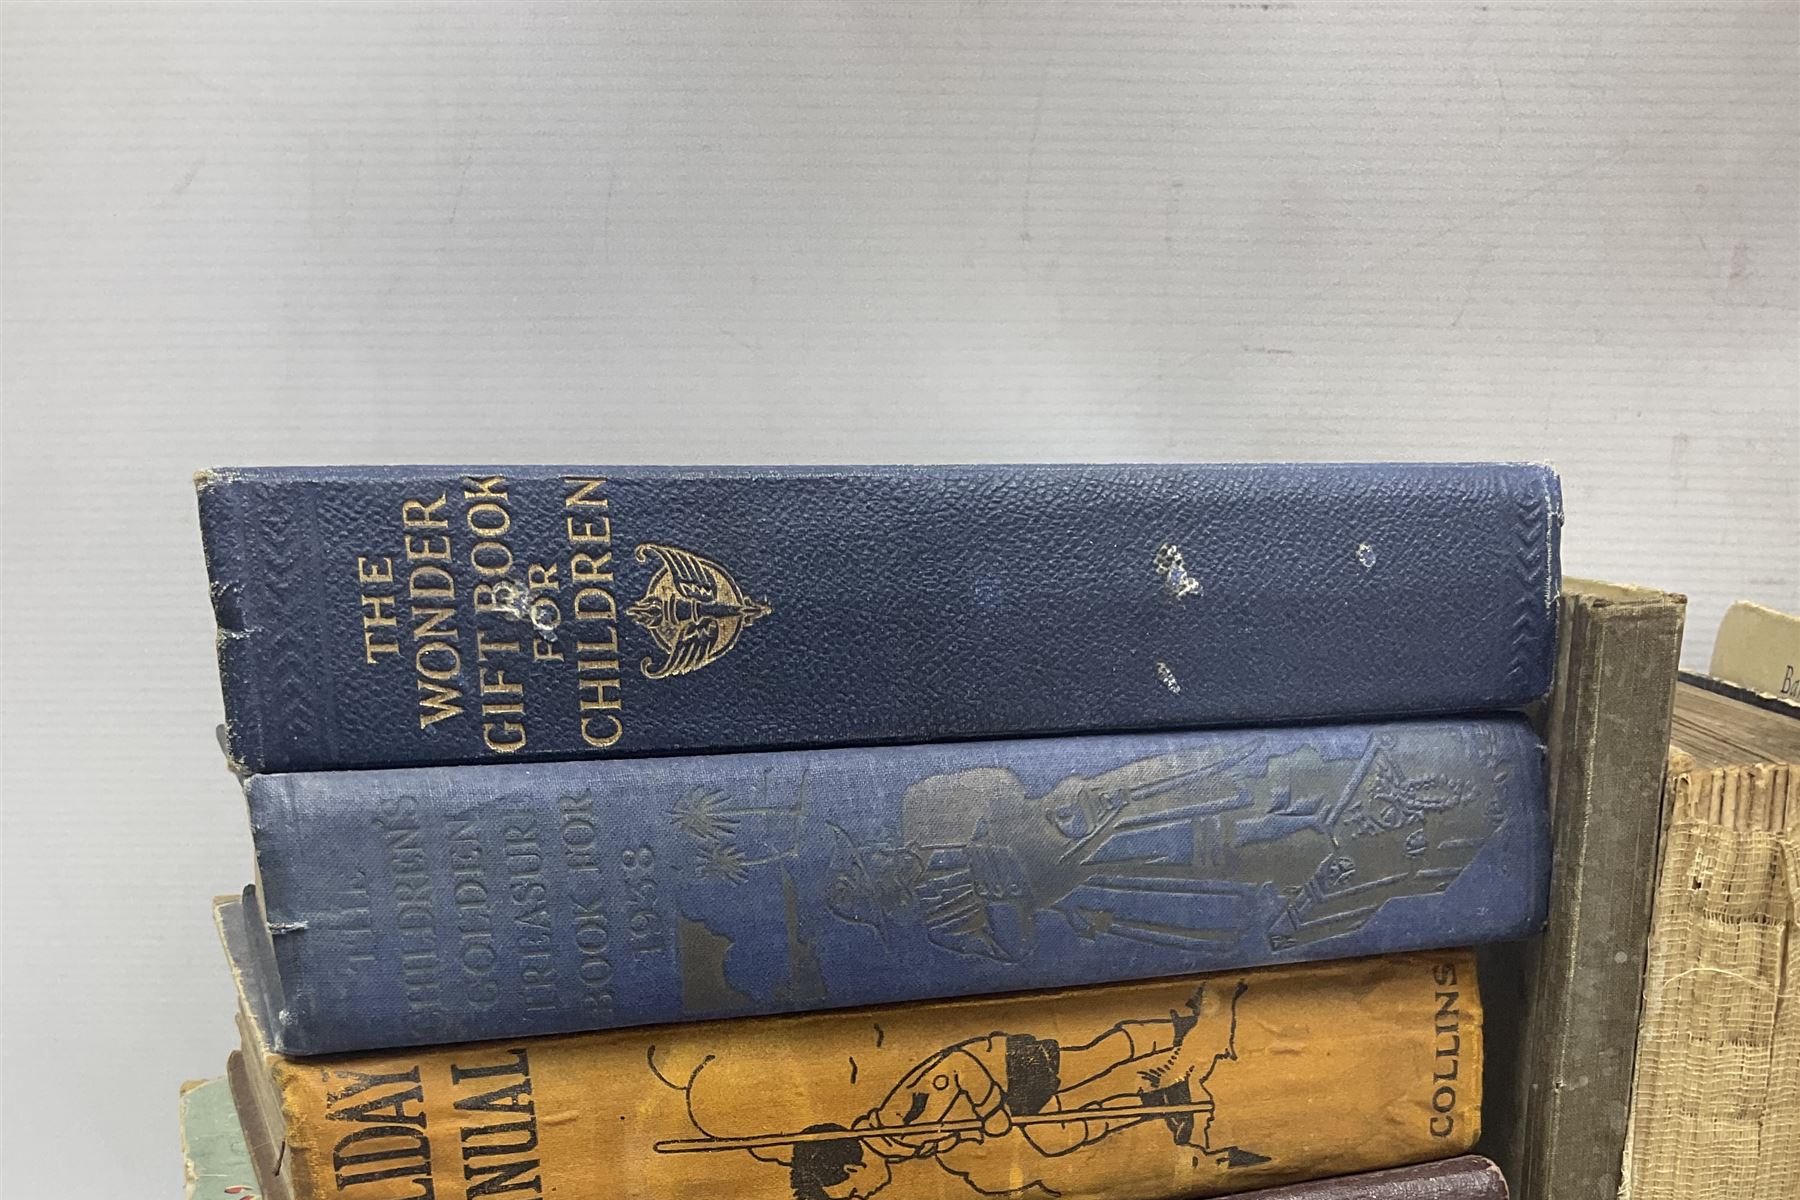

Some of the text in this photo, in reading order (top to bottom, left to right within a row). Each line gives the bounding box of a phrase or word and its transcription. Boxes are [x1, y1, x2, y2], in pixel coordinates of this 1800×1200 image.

[358, 555, 401, 665] THE
[402, 492, 464, 730] WONDER
[463, 474, 527, 754] GIFT BOOK
[527, 562, 565, 663] FOR
[565, 475, 625, 748] CHILDREN
[446, 808, 499, 1010] GOLDEN
[559, 787, 614, 1015] BOOK FOR
[1429, 962, 1461, 1139] COLLINS
